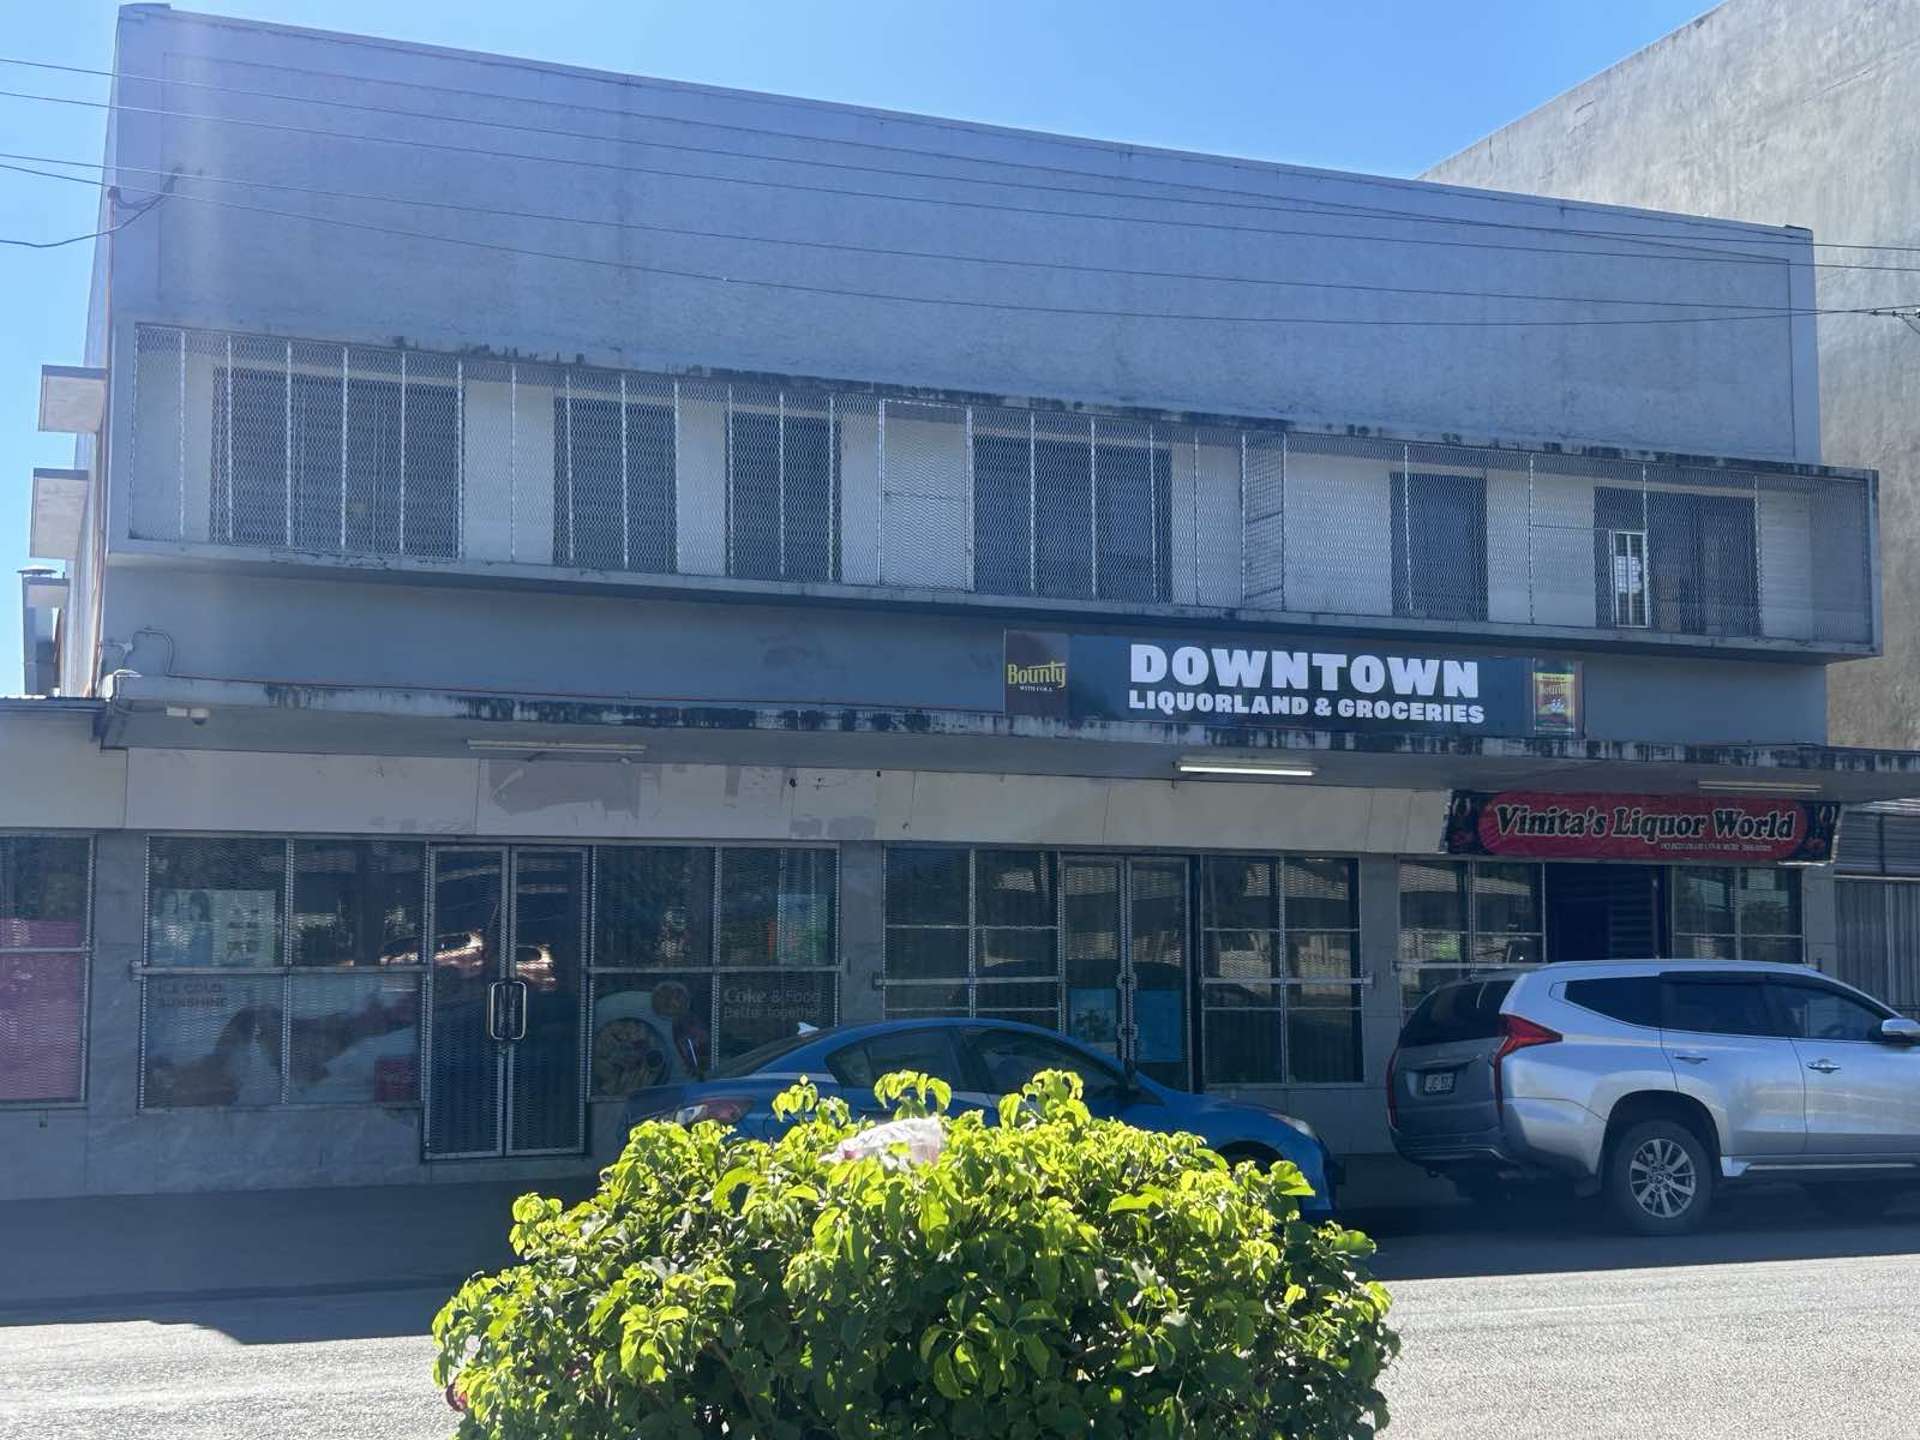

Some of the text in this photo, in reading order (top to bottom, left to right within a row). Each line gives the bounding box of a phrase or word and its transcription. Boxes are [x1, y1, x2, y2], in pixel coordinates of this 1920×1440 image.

[1007, 660, 1067, 688] Bounty
[1131, 644, 1479, 698] DOWNTOWN
[1129, 690, 1485, 724] LIQUORLAND & GROCERIES
[1497, 804, 1796, 844] Vinita's Liquor World
[724, 987, 767, 1004] Coke
